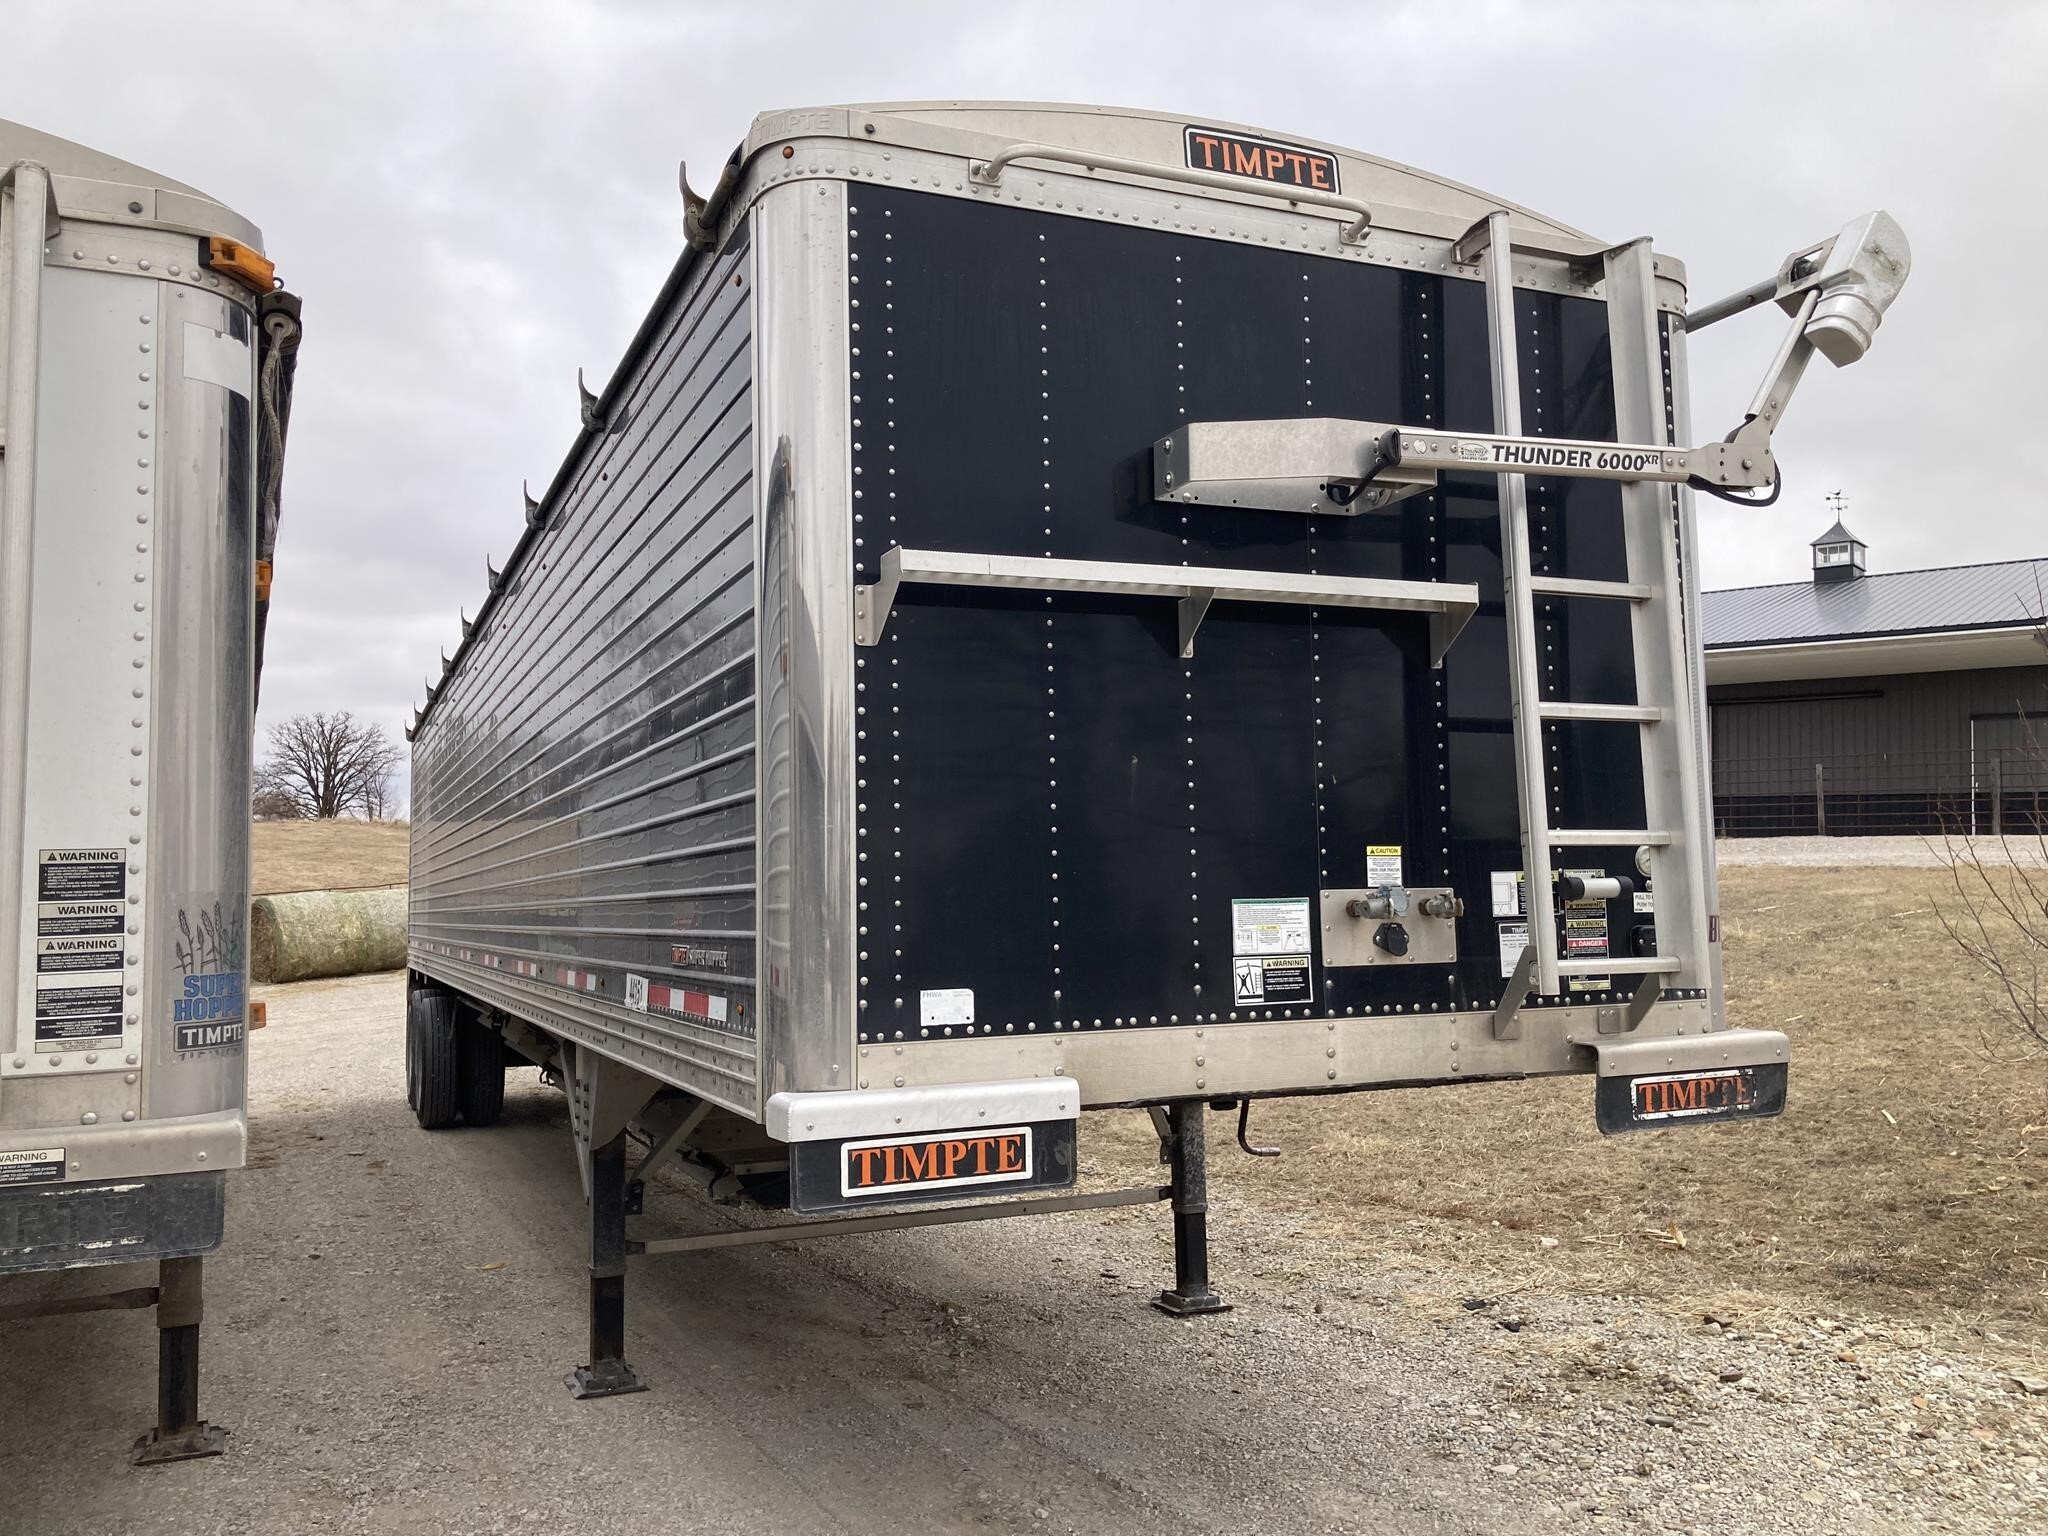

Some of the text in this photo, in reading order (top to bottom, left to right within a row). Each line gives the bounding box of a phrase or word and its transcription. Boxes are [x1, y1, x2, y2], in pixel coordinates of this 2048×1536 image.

[1195, 136, 1330, 189] TIMPTE
[1491, 445, 1593, 468] THUNDER
[59, 851, 119, 861] WARNING
[57, 905, 118, 914] WARNING
[57, 940, 117, 950] WARNING
[184, 973, 243, 997] SUPE
[182, 1023, 242, 1046] TIMPTE
[1638, 1077, 1752, 1113] TIMPTE
[851, 1135, 1023, 1187] TIMPTE
